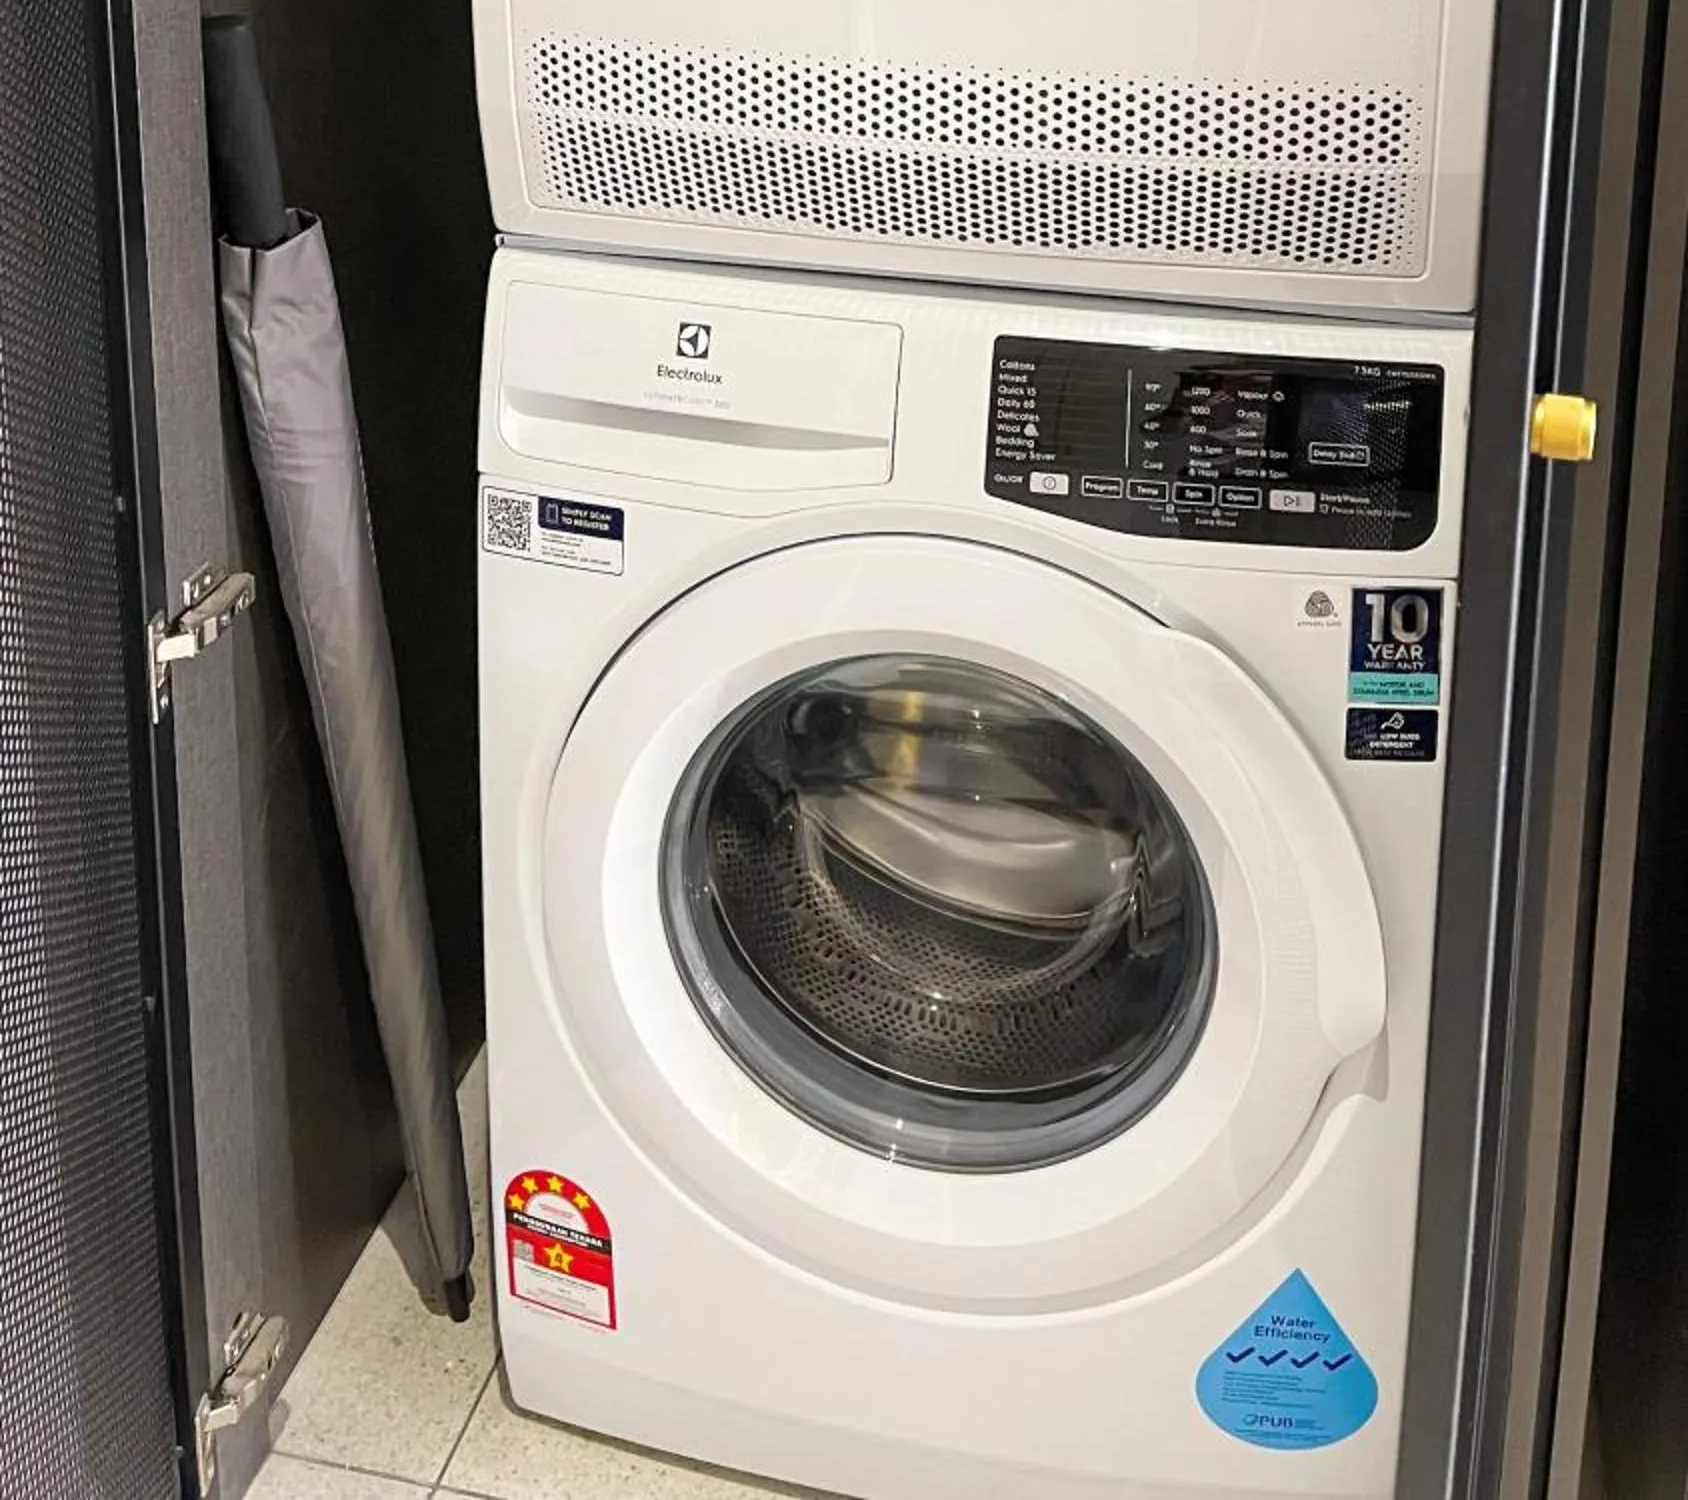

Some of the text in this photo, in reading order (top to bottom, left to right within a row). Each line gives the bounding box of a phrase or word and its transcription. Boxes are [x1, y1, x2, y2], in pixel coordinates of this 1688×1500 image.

[1000, 359, 1035, 371] Cottons
[656, 364, 723, 385] Electrolux
[999, 373, 1028, 383] Mixed
[998, 385, 1037, 396] Quick 15
[997, 410, 1040, 422] Delicates
[1191, 406, 1211, 415] 1000
[996, 423, 1020, 433] Wool
[995, 435, 1035, 449] Bedding
[1189, 445, 1223, 455] No Spin
[1235, 448, 1258, 457] Rinse
[1269, 450, 1288, 459] Spin
[1235, 468, 1258, 476] Drain
[1269, 470, 1288, 479] Spin
[1185, 489, 1203, 499] Spin
[561, 516, 573, 525] TO
[589, 509, 612, 521] SCAN
[1365, 593, 1429, 643] 10
[1367, 643, 1424, 660] YEAR
[1271, 1315, 1316, 1329] Water
[1254, 1325, 1331, 1344] Efficiency
